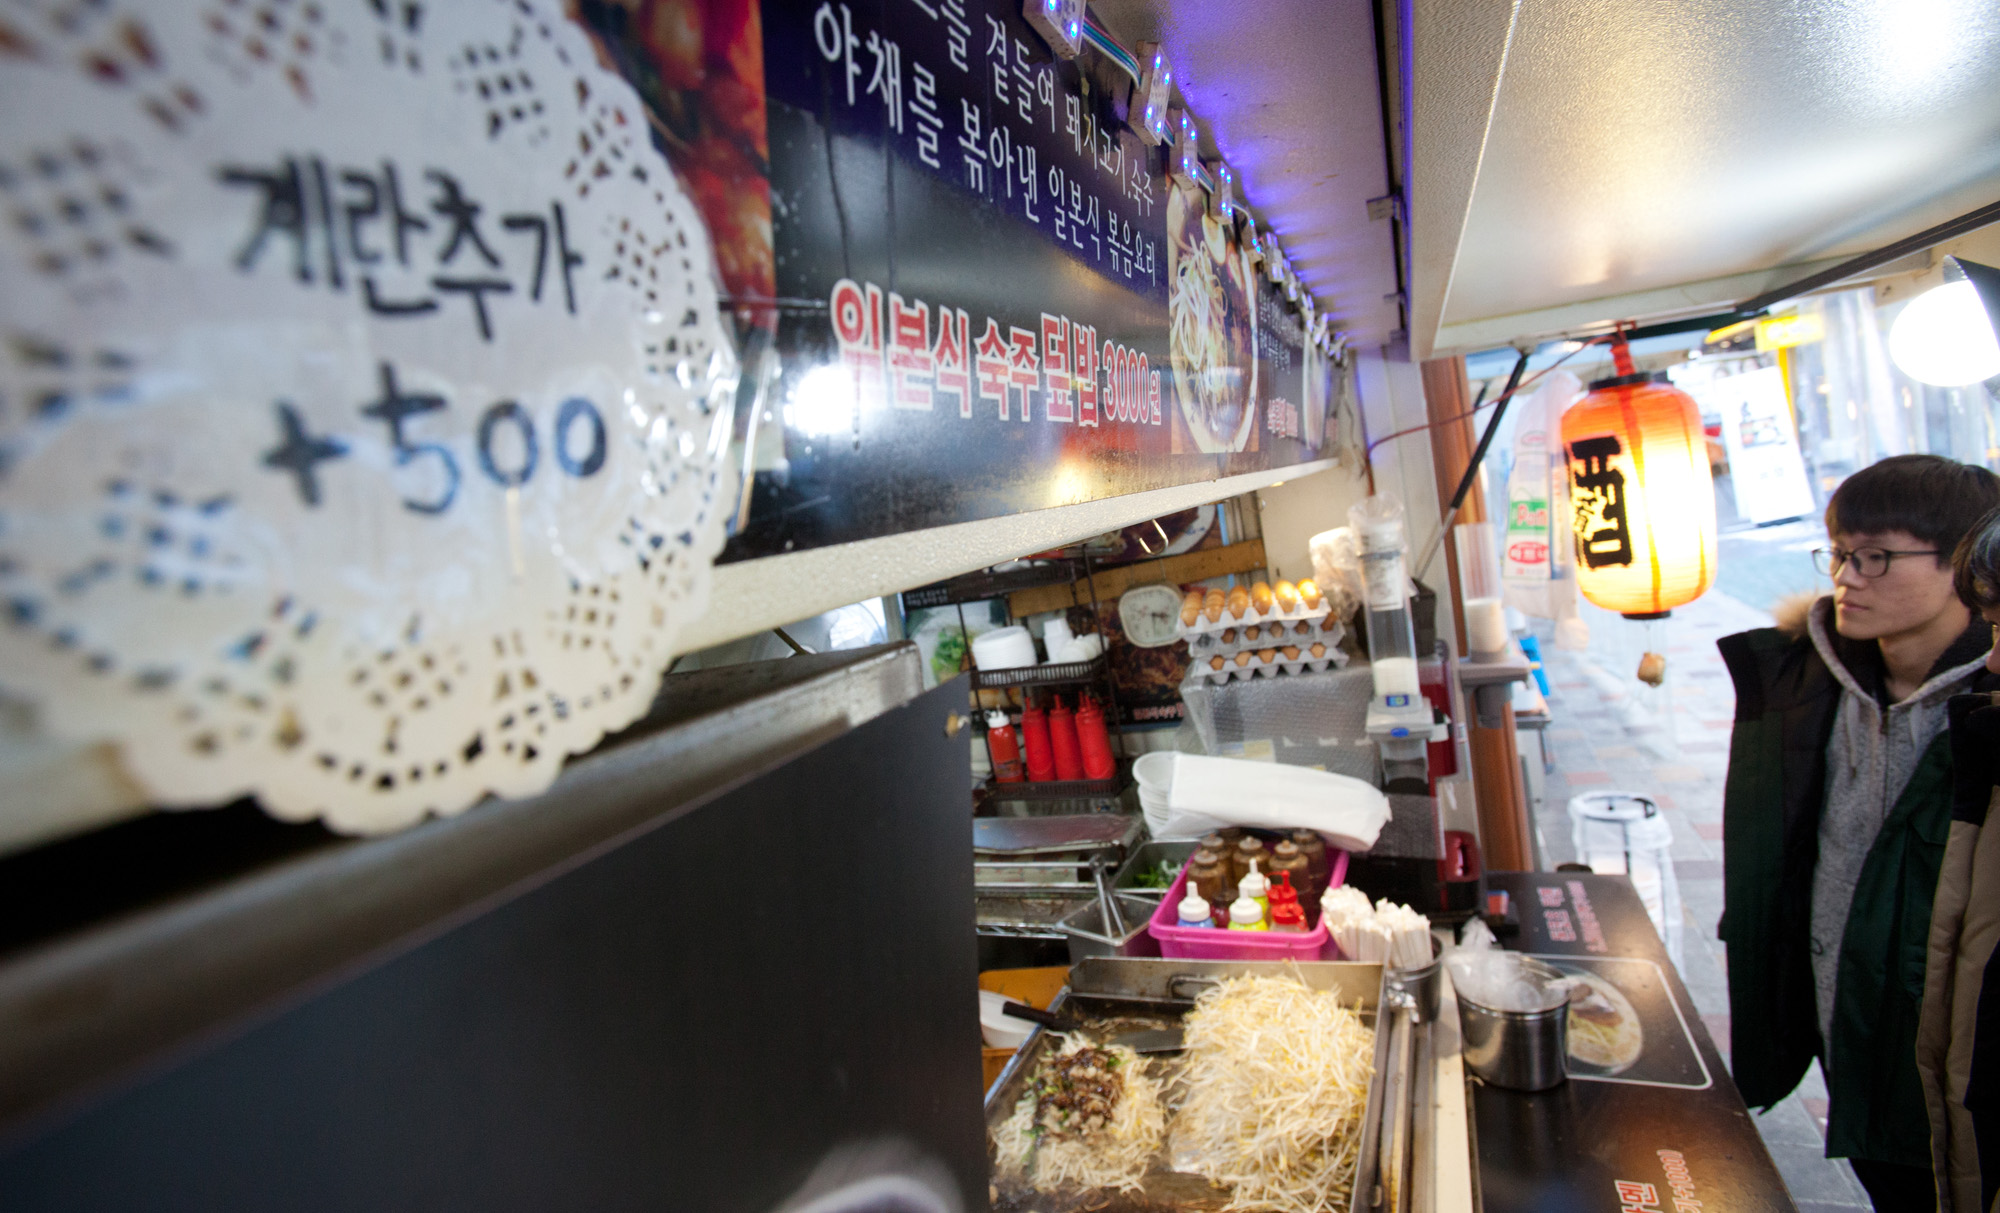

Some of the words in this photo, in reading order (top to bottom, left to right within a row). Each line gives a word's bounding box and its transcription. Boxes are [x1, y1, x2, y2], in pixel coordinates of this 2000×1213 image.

[814, 2, 943, 169] 야채를
[958, 98, 1039, 223] 볶아낸
[1049, 165, 1100, 261] 일본식
[1107, 210, 1155, 287] 볶음요리
[911, 0, 971, 73] 를
[985, 13, 1056, 133] 곁들여
